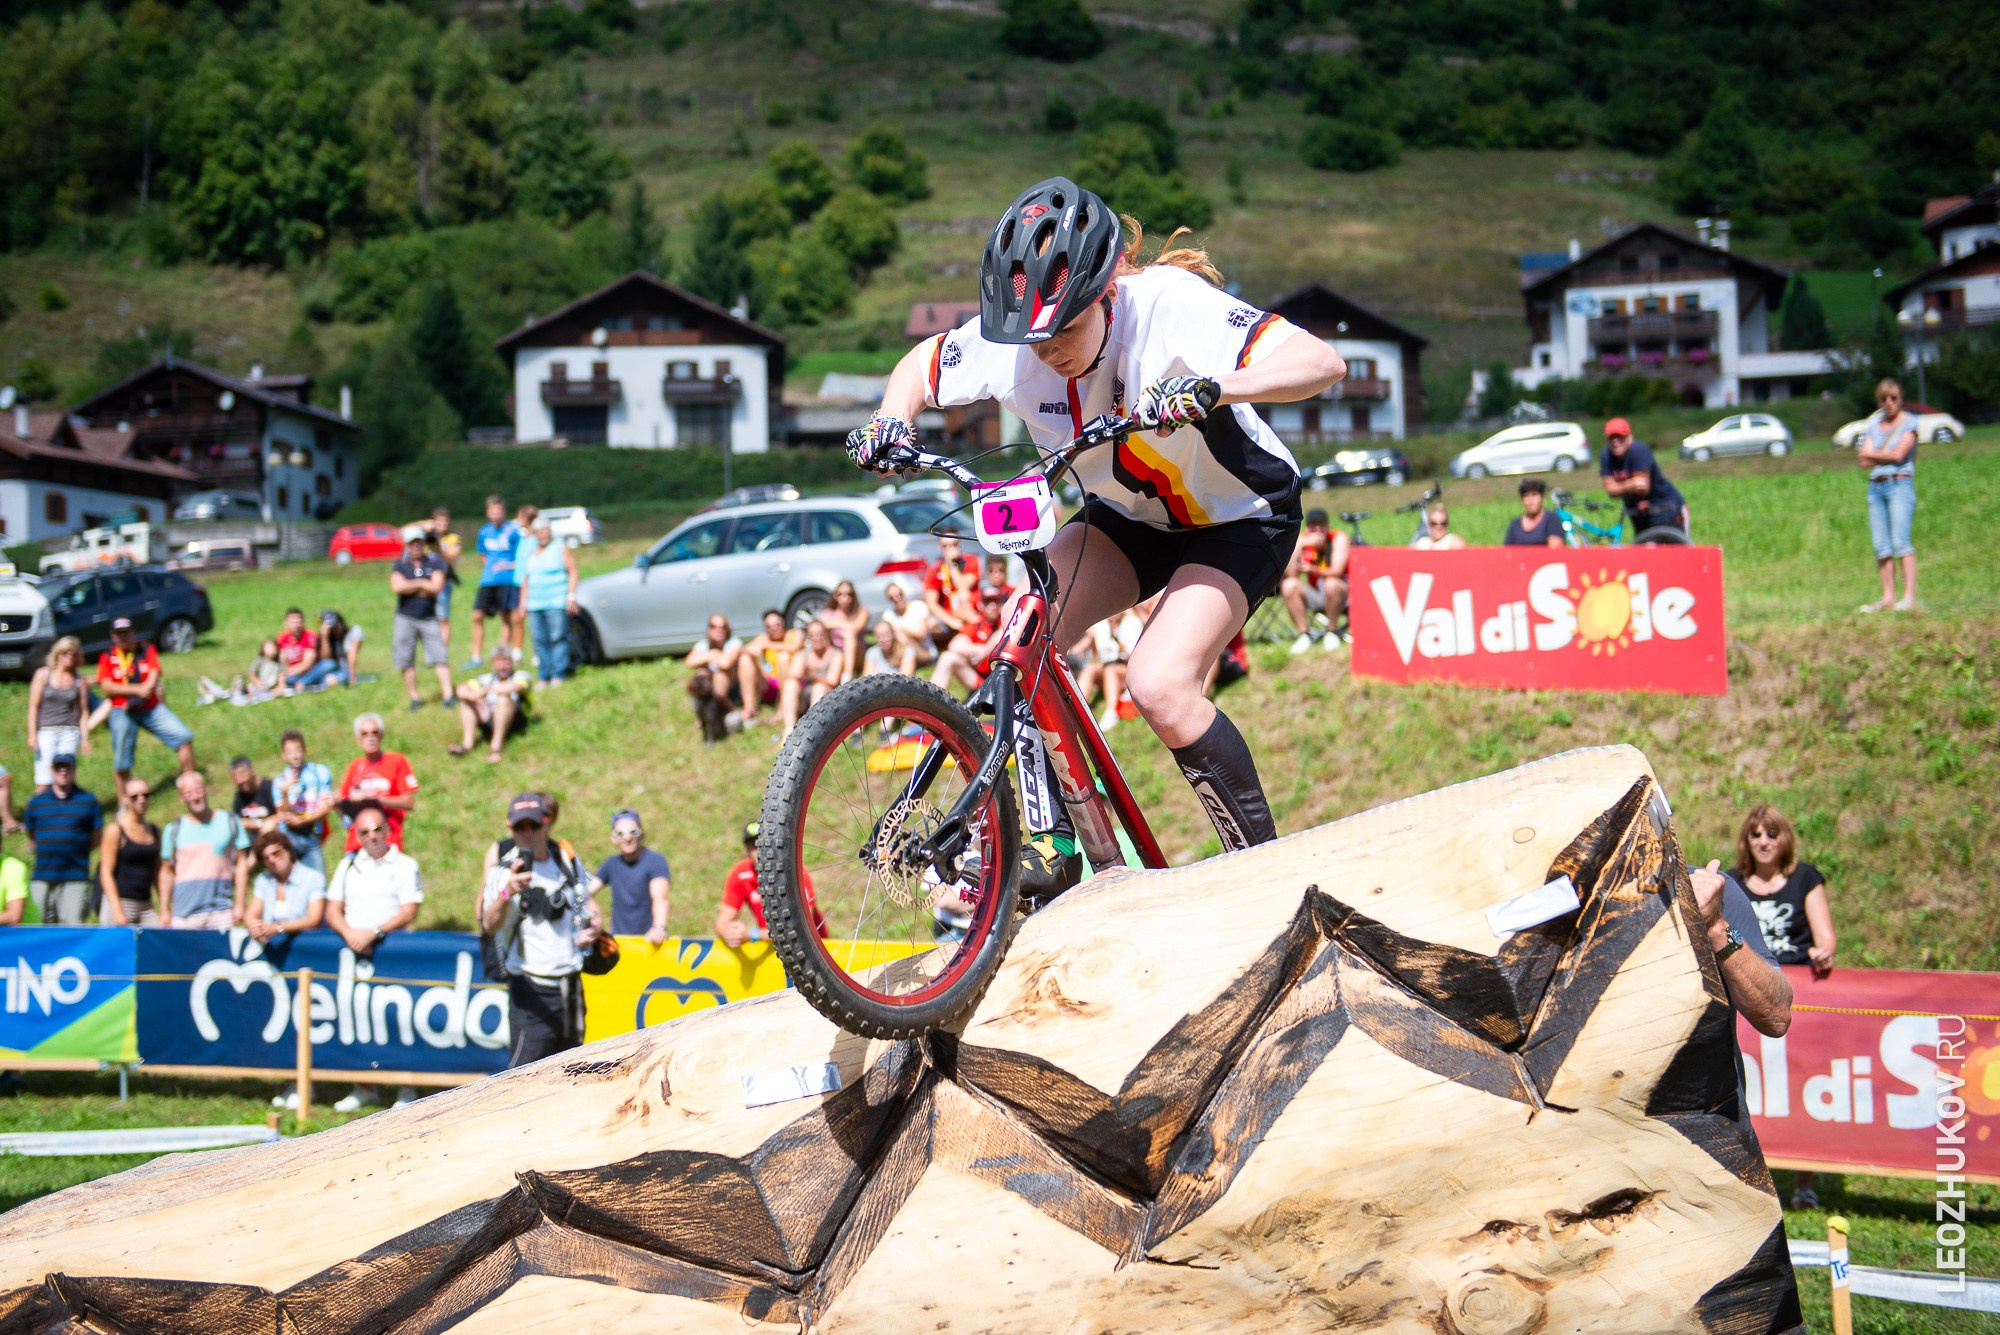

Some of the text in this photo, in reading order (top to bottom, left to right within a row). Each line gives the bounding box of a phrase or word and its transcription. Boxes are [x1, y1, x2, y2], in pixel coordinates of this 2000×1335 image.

[1023, 331, 1052, 339] ALPINA
[997, 538, 1030, 551] TRENTINO
[998, 504, 1018, 532] 2
[1369, 571, 1476, 666] Val
[1480, 600, 1531, 654] di
[1018, 735, 1043, 830] CLEAN
[190, 947, 511, 1049] Melinda
[1802, 1055, 1874, 1124] di
